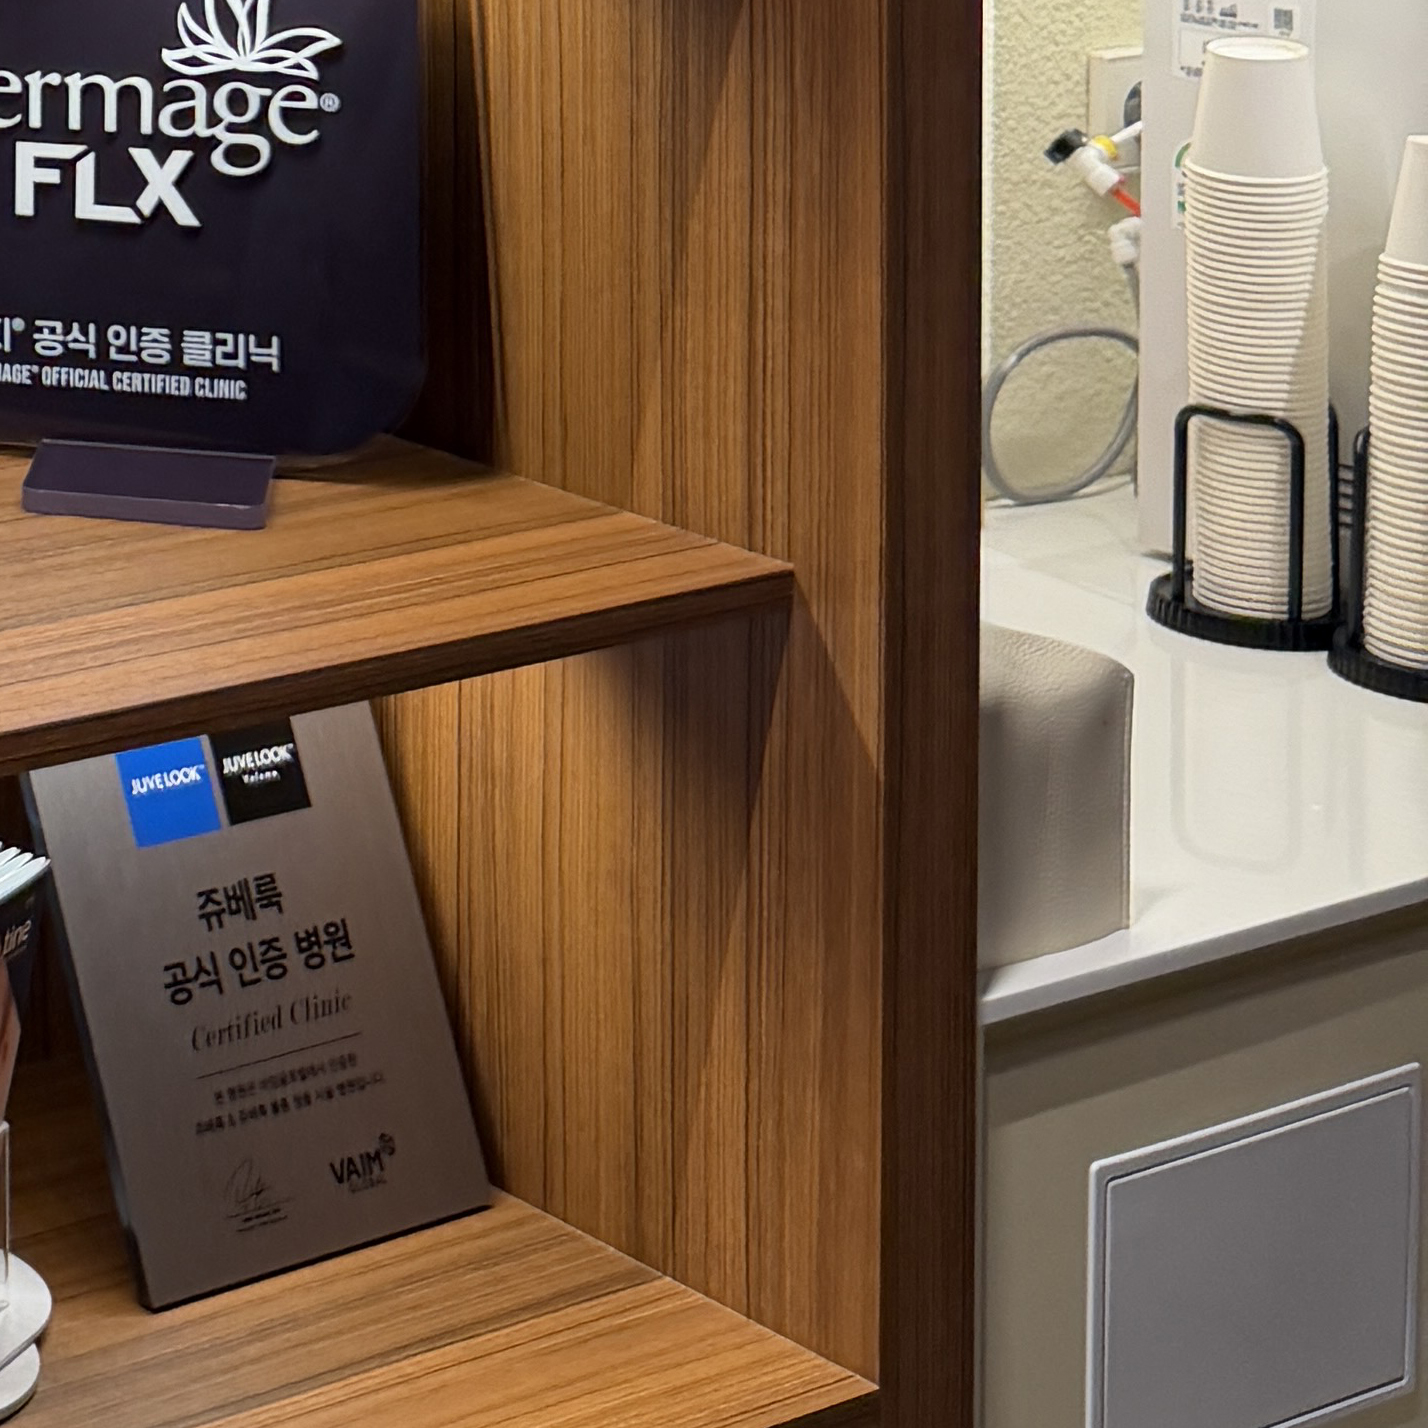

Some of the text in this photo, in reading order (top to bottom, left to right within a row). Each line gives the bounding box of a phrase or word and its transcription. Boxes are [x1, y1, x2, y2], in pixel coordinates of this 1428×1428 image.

[14, 140, 202, 229] FLX
[32, 318, 96, 359] 공식
[106, 323, 172, 365] 인증
[179, 329, 281, 373] 클리닉
[41, 365, 109, 391] OFFICIAL
[112, 370, 192, 397] CERTIFIED
[194, 375, 248, 401] CLINIC
[196, 872, 284, 933] 쥬베룩
[163, 917, 356, 1006] 공식 인증 병원
[191, 987, 353, 1052] Certified Clinic
[330, 1148, 386, 1185] VAIM
